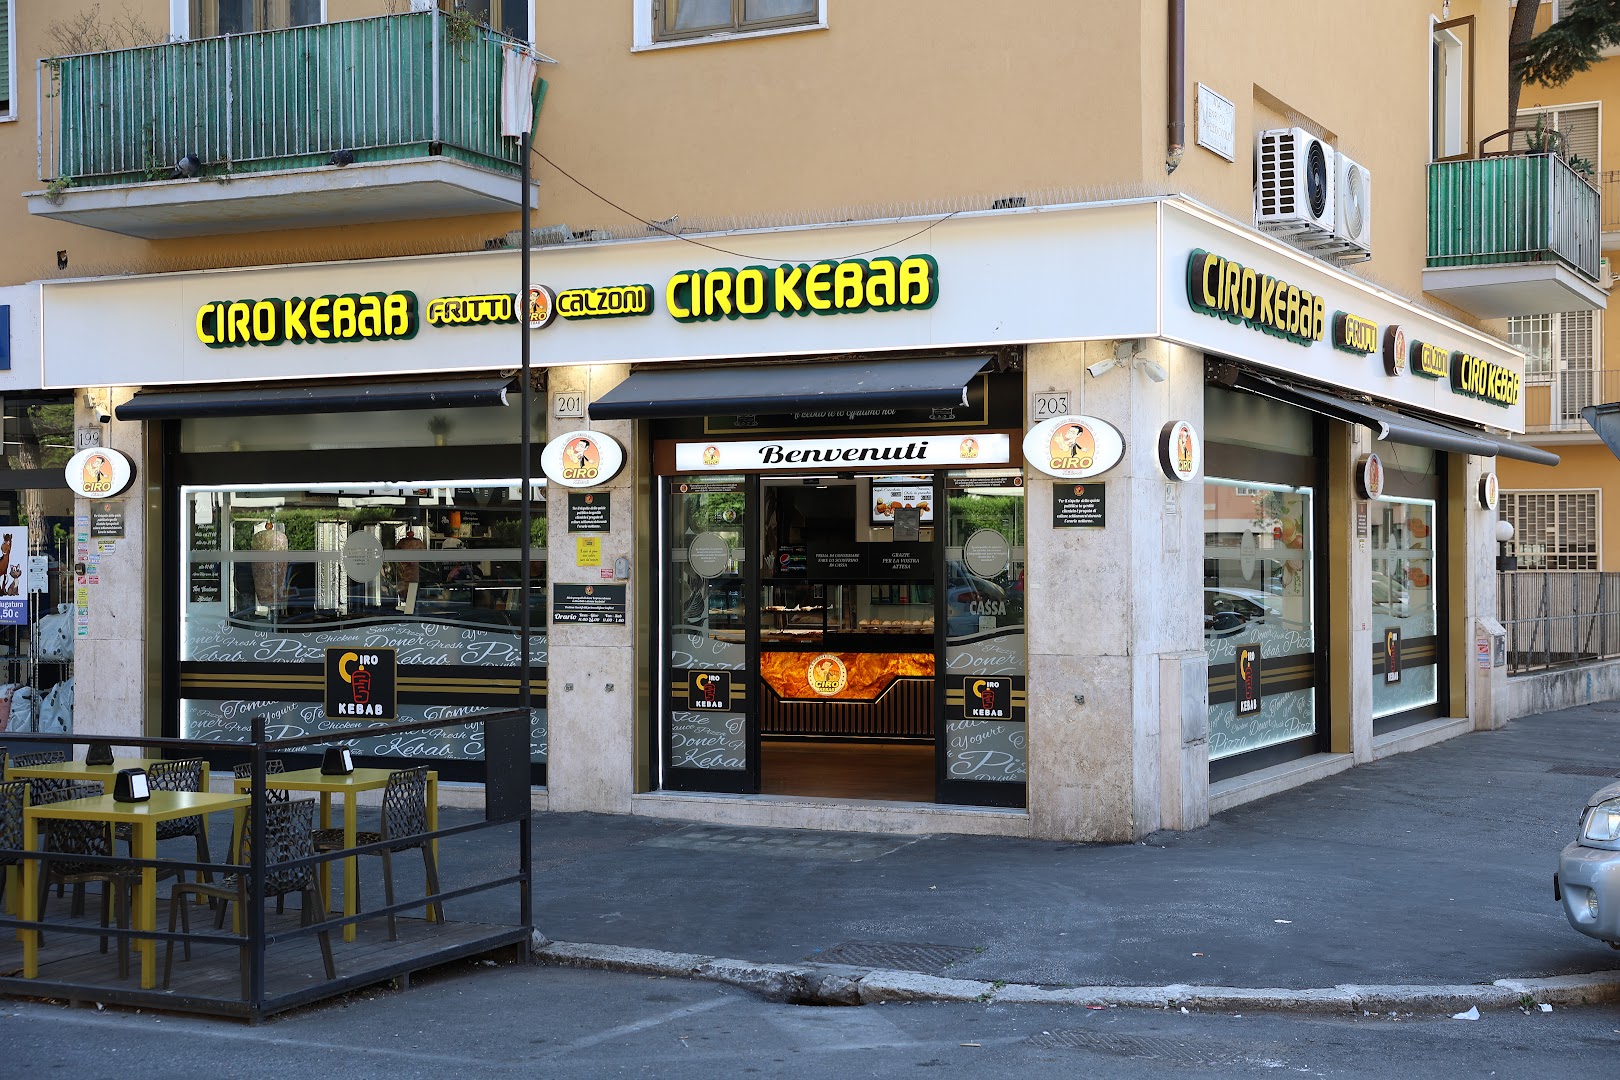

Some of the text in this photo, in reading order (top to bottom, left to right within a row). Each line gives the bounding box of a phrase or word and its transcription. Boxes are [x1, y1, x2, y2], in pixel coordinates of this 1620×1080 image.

[666, 270, 763, 318] CIRO
[1203, 254, 1256, 318] CIRO
[426, 295, 511, 324] FRITTI
[196, 302, 276, 344] CIRO
[1345, 314, 1378, 353] FRITTI
[1461, 354, 1488, 395] CIRO
[558, 397, 580, 411] 201
[1037, 397, 1067, 414] 203
[80, 432, 99, 446] 199
[758, 441, 929, 464] Benvenuti
[1050, 457, 1093, 469] CIRO
[1178, 460, 1192, 472] CIRO
[563, 467, 598, 479] CIRO
[83, 482, 111, 492] CIRO
[0, 601, 24, 609] ugatura
[223, 637, 257, 647] Fresh
[315, 634, 360, 644] Chicken
[364, 634, 428, 648] Doner
[427, 640, 464, 649] Fresh
[1283, 631, 1313, 652] Pizz
[190, 645, 244, 662] Kebab
[254, 639, 326, 660] Piz
[461, 641, 547, 664] Piz
[1208, 638, 1237, 661] Piz
[338, 652, 379, 683] CIRO
[946, 652, 1021, 669] Doner
[815, 680, 839, 688] CIRO
[258, 702, 299, 725] Yogurt
[338, 703, 383, 716] KEBAB
[972, 709, 1003, 717] KEBAB
[225, 722, 252, 732] Fres
[318, 720, 362, 731] Chicken
[429, 728, 467, 739] Fresh
[672, 732, 728, 748] Doner
[951, 725, 1006, 750] Yogurt
[374, 737, 452, 758] Kebab
[950, 750, 1026, 775] Piz
